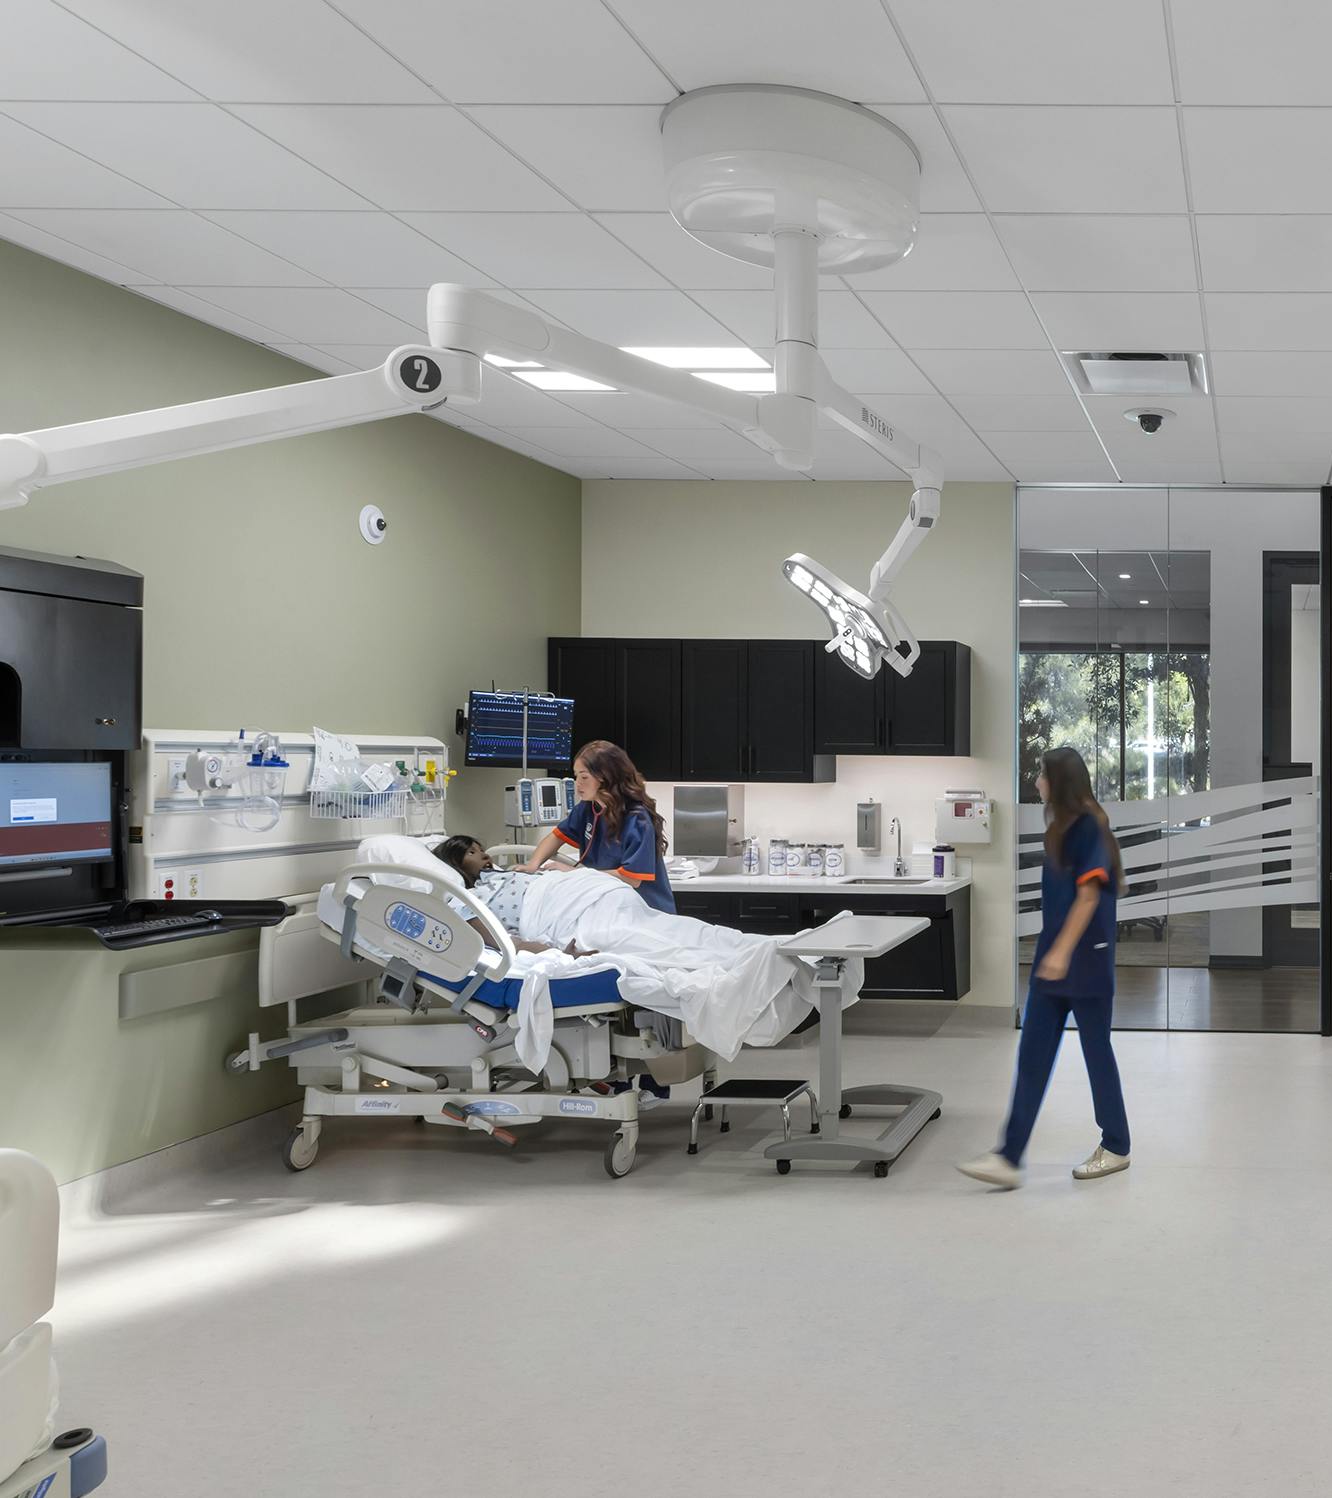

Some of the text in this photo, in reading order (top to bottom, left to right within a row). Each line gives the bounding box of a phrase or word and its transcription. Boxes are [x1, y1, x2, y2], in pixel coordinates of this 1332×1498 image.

[413, 359, 429, 389] 2
[869, 413, 894, 441] STERIS
[562, 1101, 593, 1112] Hill-Rom
